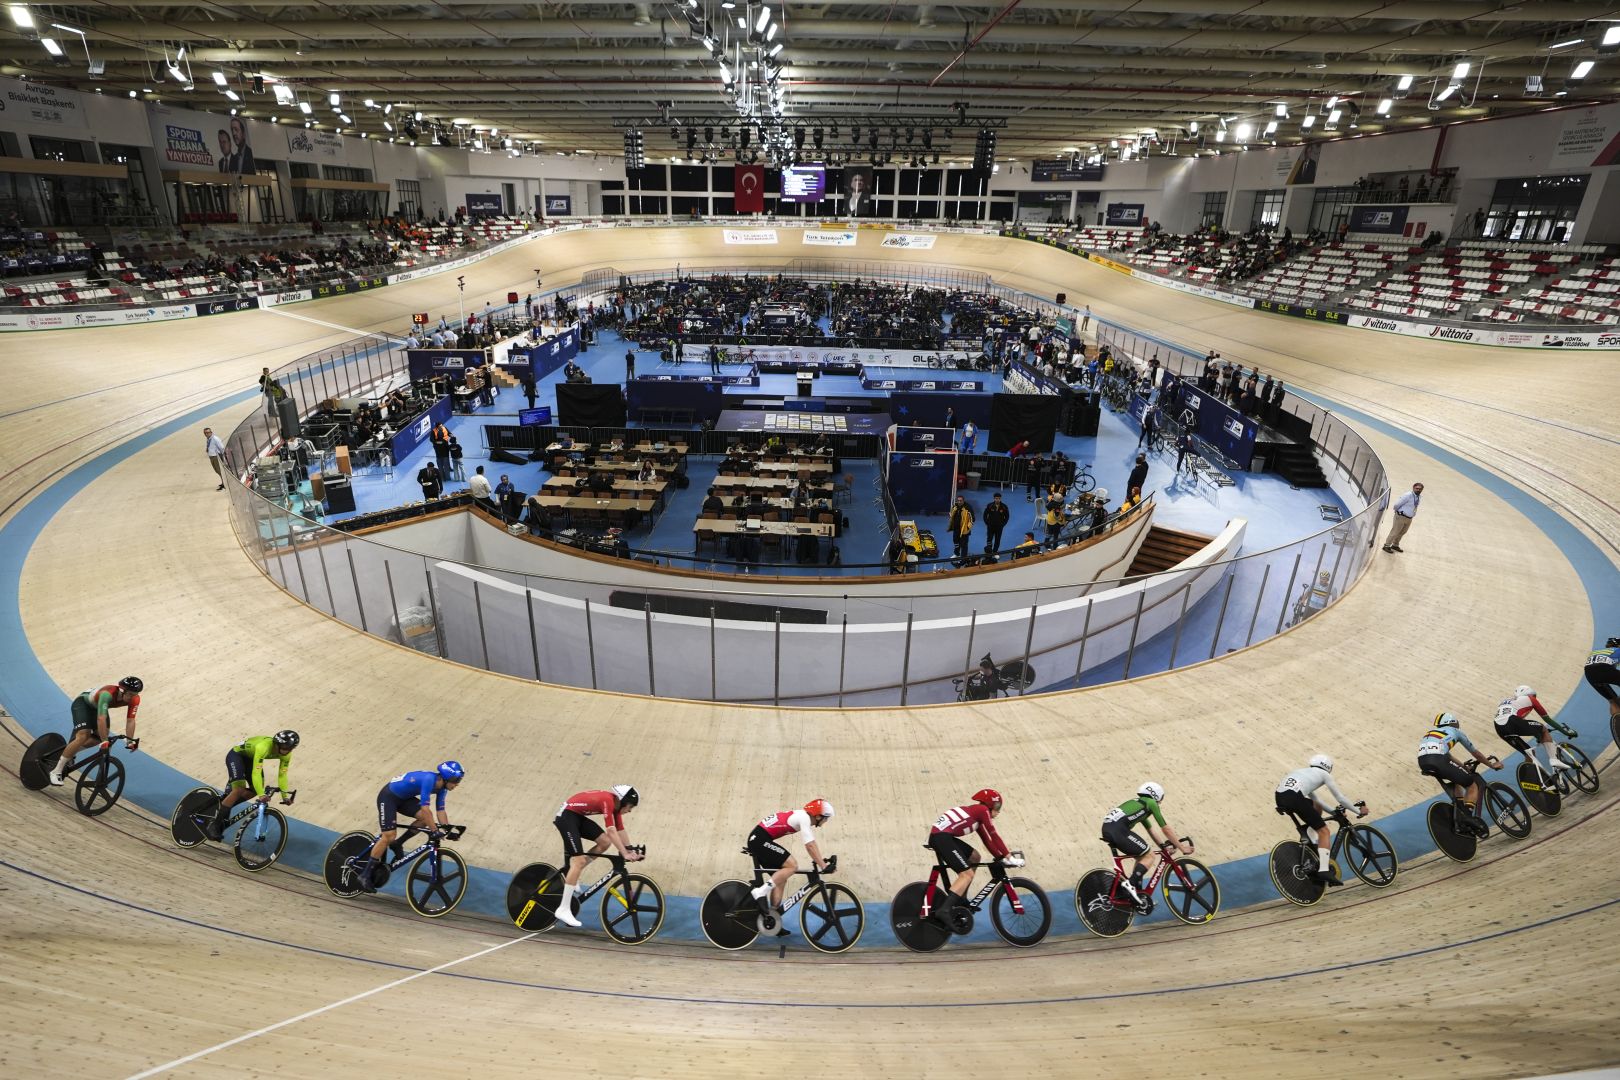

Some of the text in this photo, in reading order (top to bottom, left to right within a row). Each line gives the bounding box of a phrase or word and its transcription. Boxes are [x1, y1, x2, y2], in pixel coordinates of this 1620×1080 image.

[25, 84, 55, 95] Avrupa
[8, 91, 40, 104] Bisiklet
[169, 127, 198, 141] SPORU
[169, 139, 203, 153] TABANA
[167, 151, 213, 165] YAYIYORUZ
[281, 292, 301, 301] vittoria
[414, 314, 422, 322] 23
[1370, 317, 1397, 331] vittoria
[1440, 328, 1474, 341] vittoria
[1127, 810, 1145, 821] IRELAND
[1128, 835, 1147, 850] IRELAND
[392, 844, 427, 868] PINARELLO
[782, 886, 812, 911] BMC
[969, 882, 996, 907] CANYON
[518, 903, 532, 924] MAVIC
